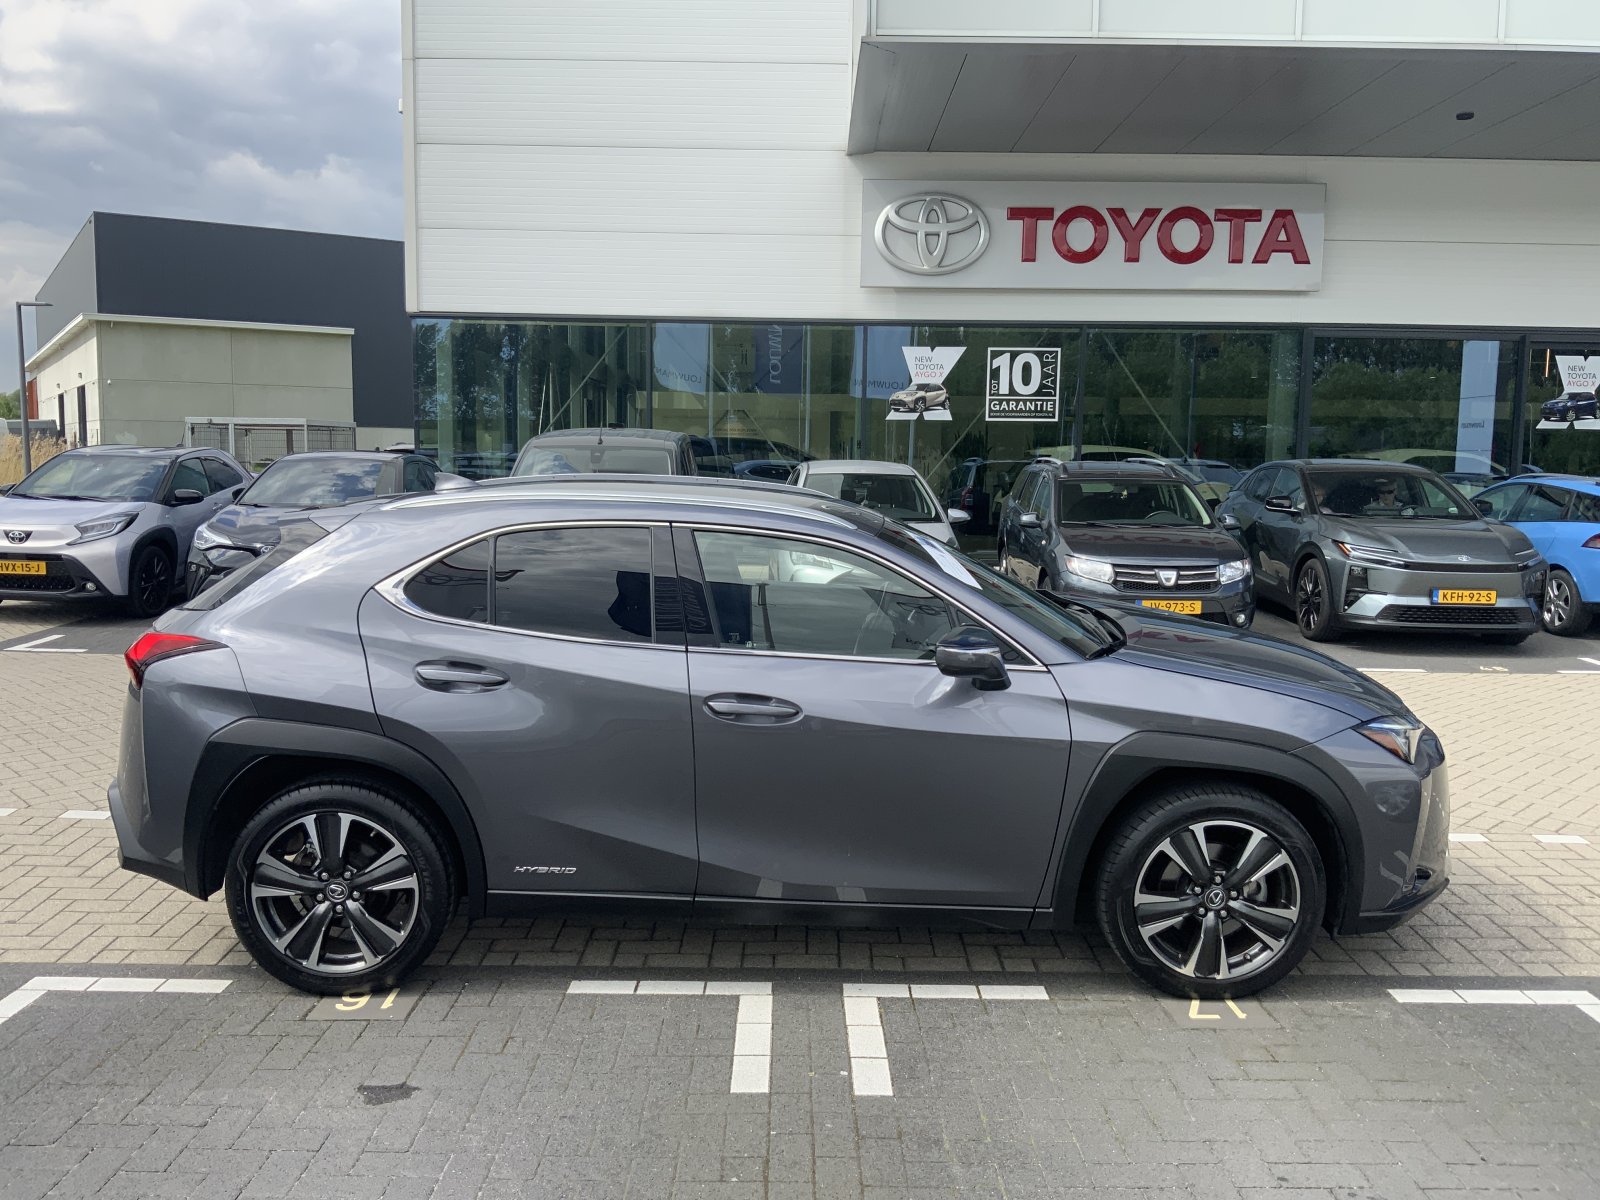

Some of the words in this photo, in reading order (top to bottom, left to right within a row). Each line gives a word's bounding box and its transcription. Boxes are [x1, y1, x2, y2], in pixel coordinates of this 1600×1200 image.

[1006, 205, 1311, 265] TOYOTA
[992, 352, 1042, 396] 10
[1042, 353, 1056, 395] JAAR
[1567, 372, 1597, 380] TOYOTA
[991, 379, 999, 395] TOT
[990, 400, 1054, 411] GARANTIE
[1442, 592, 1492, 602] KFH-92-S
[513, 866, 577, 874] HYBRID
